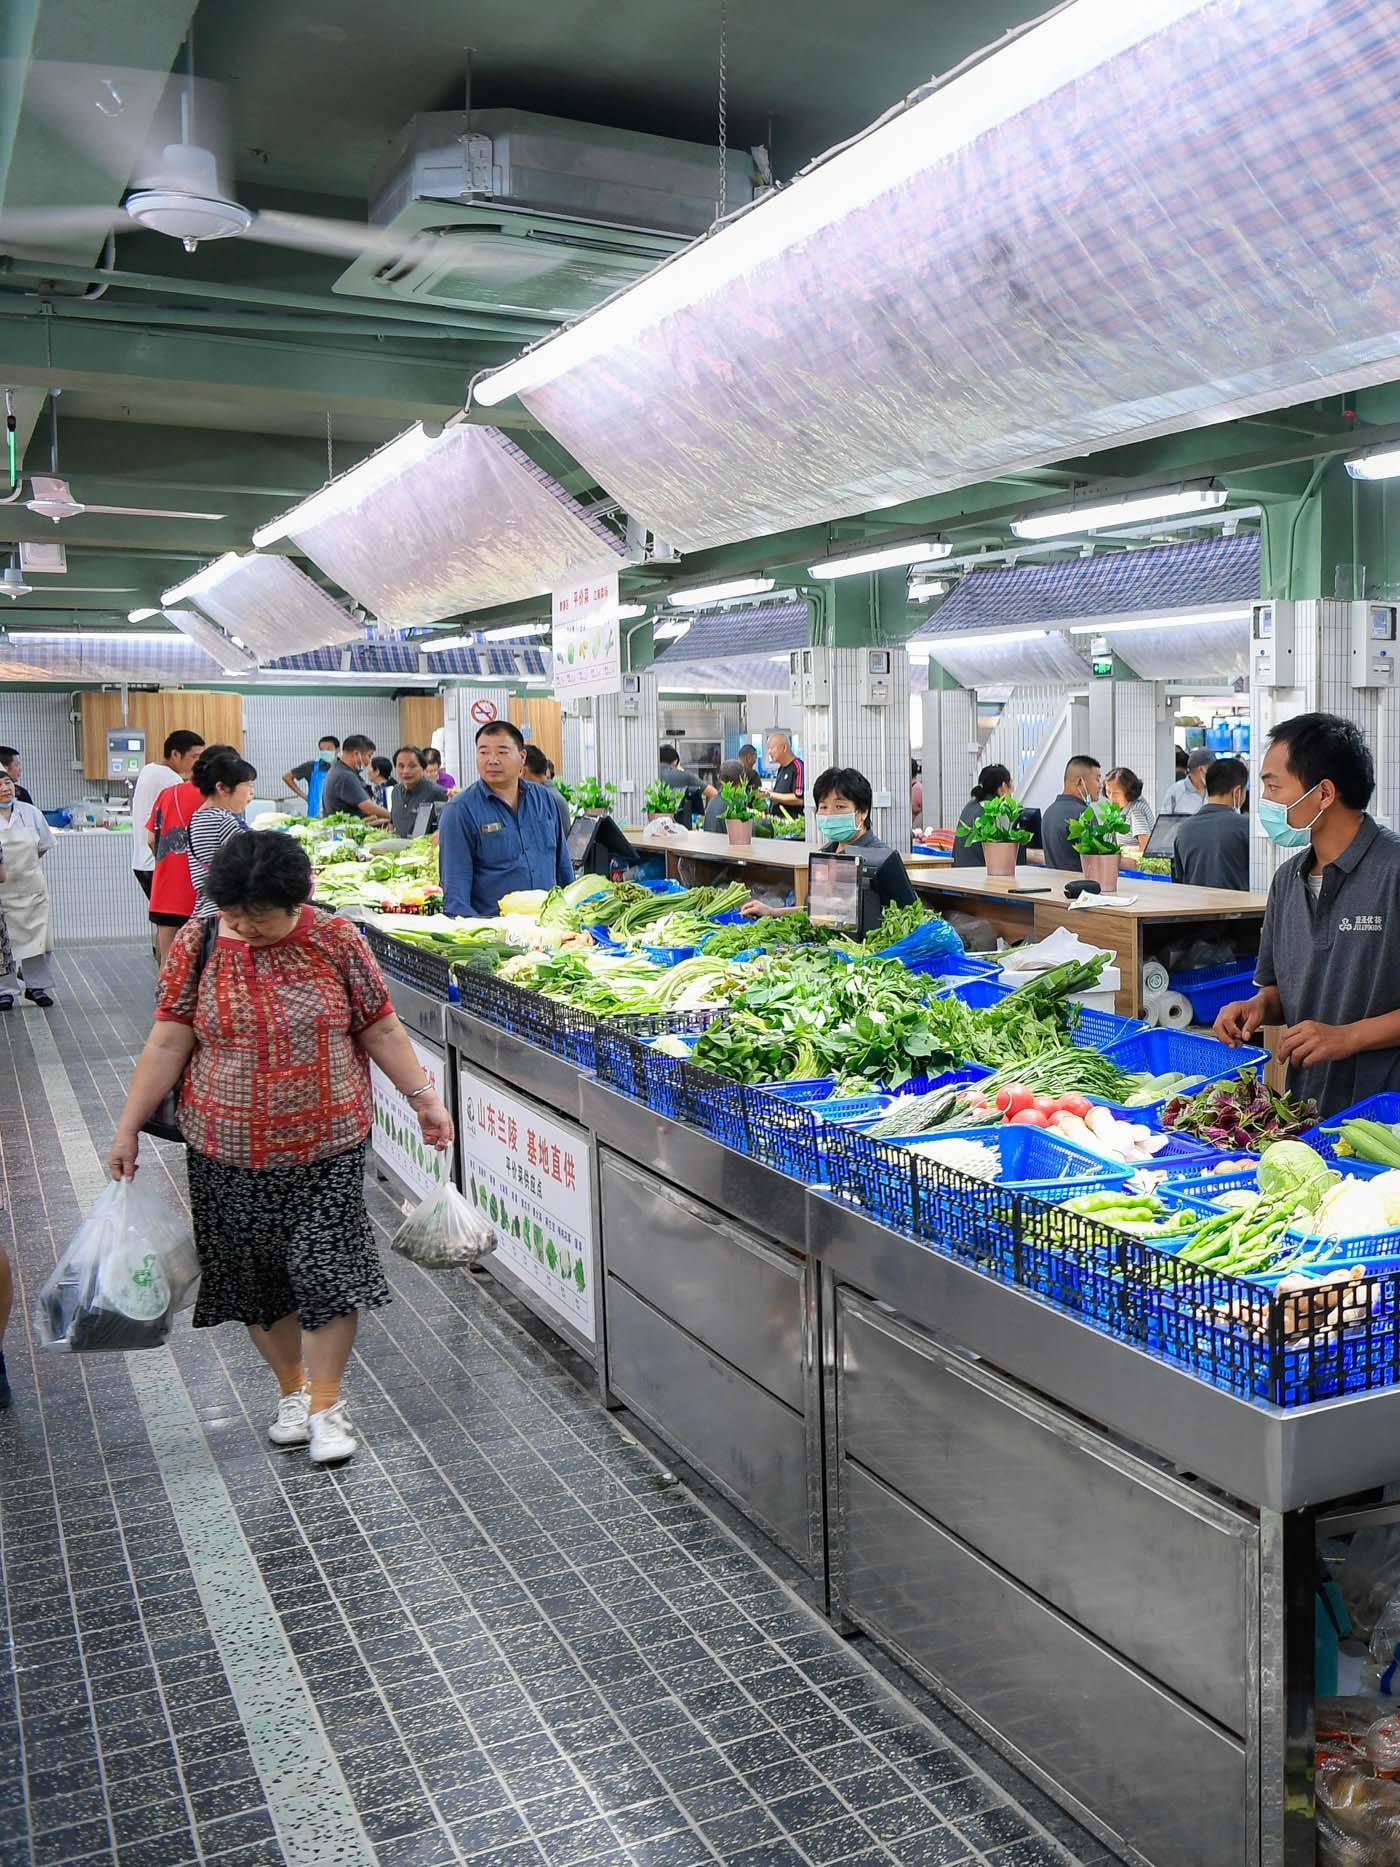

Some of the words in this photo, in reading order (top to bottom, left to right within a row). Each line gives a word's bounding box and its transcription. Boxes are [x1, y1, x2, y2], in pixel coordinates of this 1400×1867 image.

[477, 1097, 518, 1153] 山东兰陵
[526, 1128, 576, 1192] 基地直供
[505, 1156, 544, 1201] 平价菜供应点
